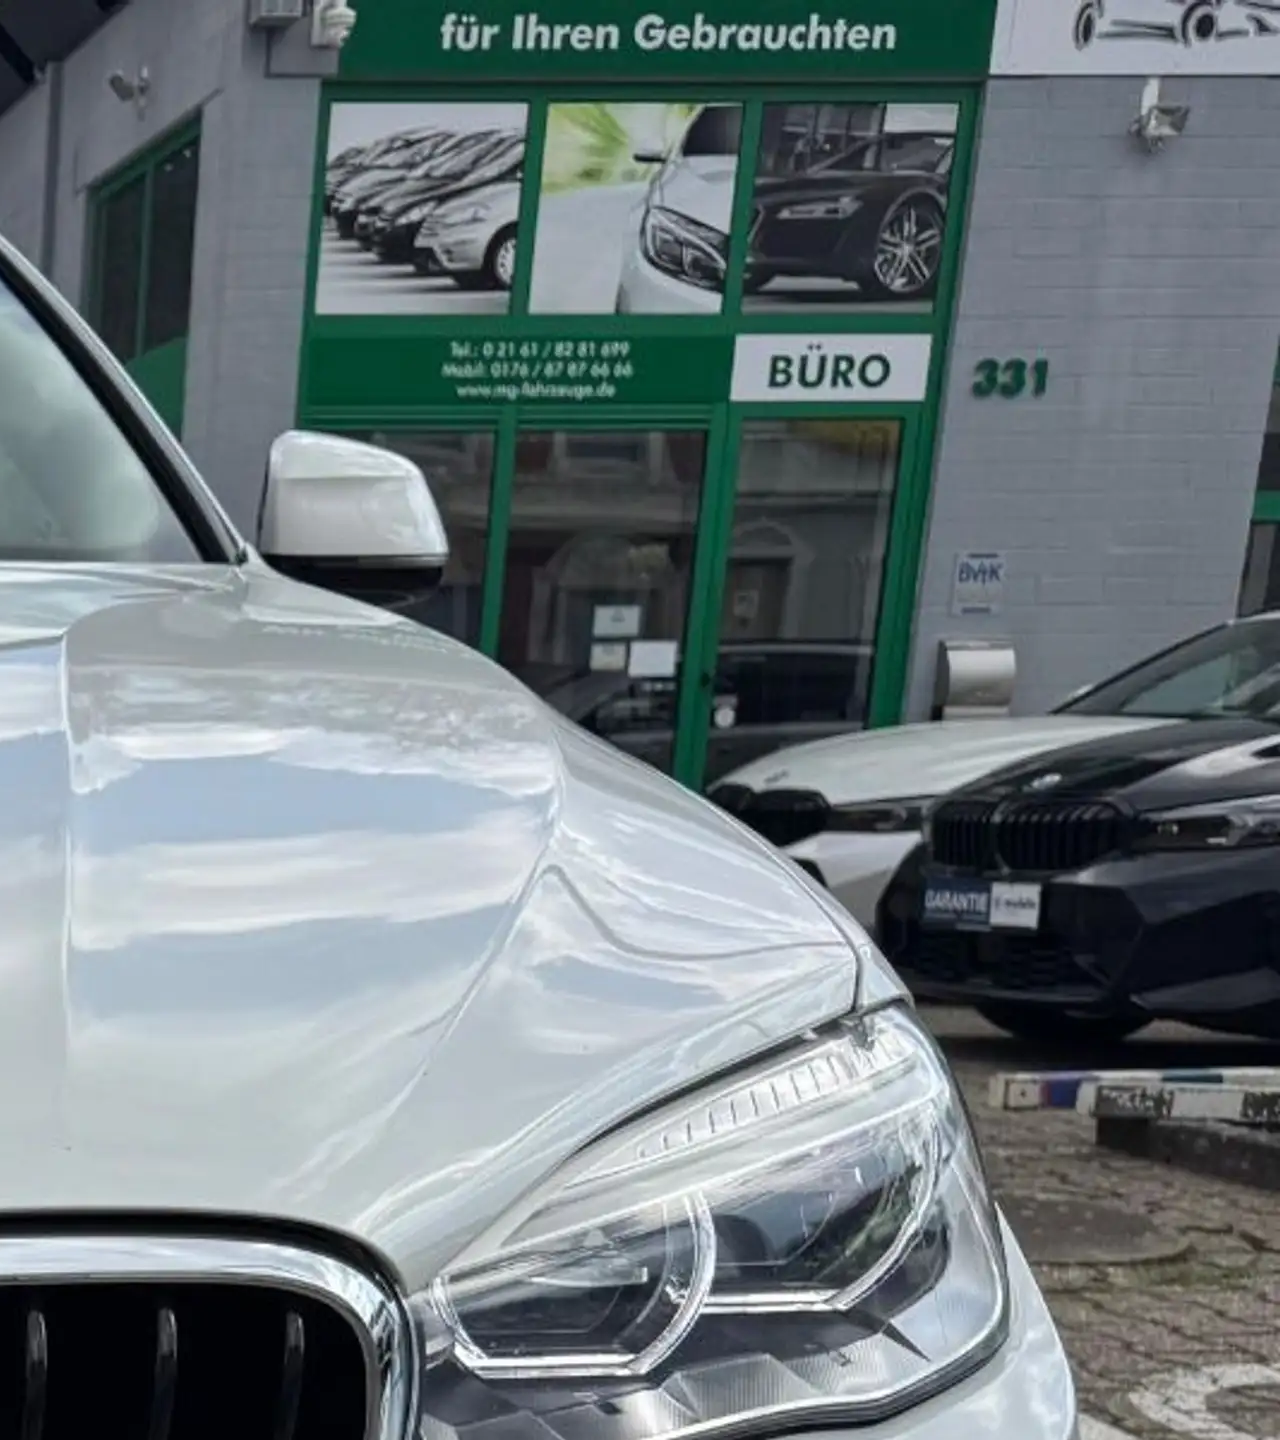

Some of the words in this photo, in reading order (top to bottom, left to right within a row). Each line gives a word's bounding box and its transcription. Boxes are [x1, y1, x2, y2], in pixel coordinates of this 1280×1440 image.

[440, 13, 500, 51] für
[511, 13, 620, 51] Ihren
[634, 13, 897, 51] Gebrauchten
[482, 340, 493, 358] 0
[767, 343, 891, 388] BÜRO
[971, 358, 1049, 398] 331
[924, 889, 989, 913] GARANTIE
